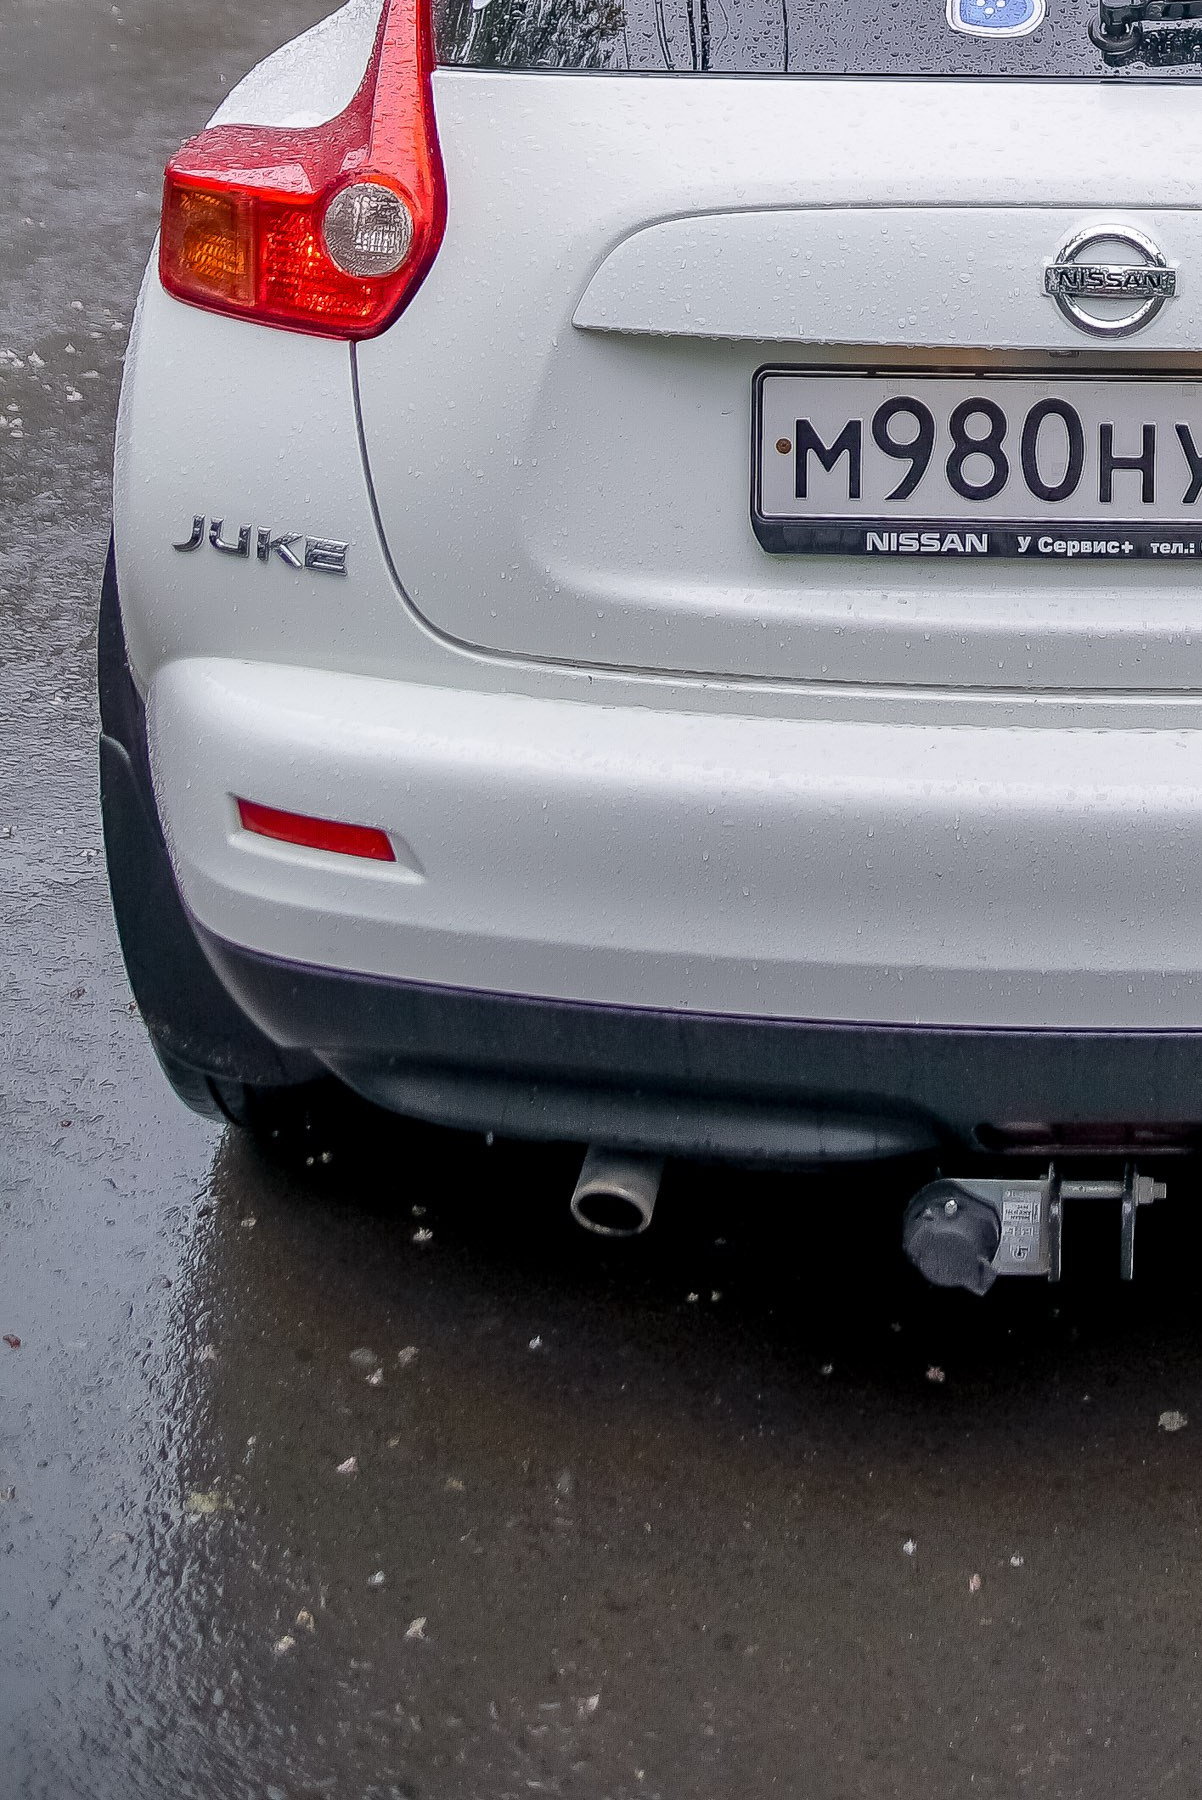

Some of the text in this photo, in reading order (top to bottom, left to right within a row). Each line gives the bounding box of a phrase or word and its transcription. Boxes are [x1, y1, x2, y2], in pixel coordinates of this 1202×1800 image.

[1058, 269, 1163, 291] NISSAN
[172, 512, 350, 577] JUKE
[866, 532, 989, 553] NISSAN
[1150, 540, 1195, 555] тел.:
